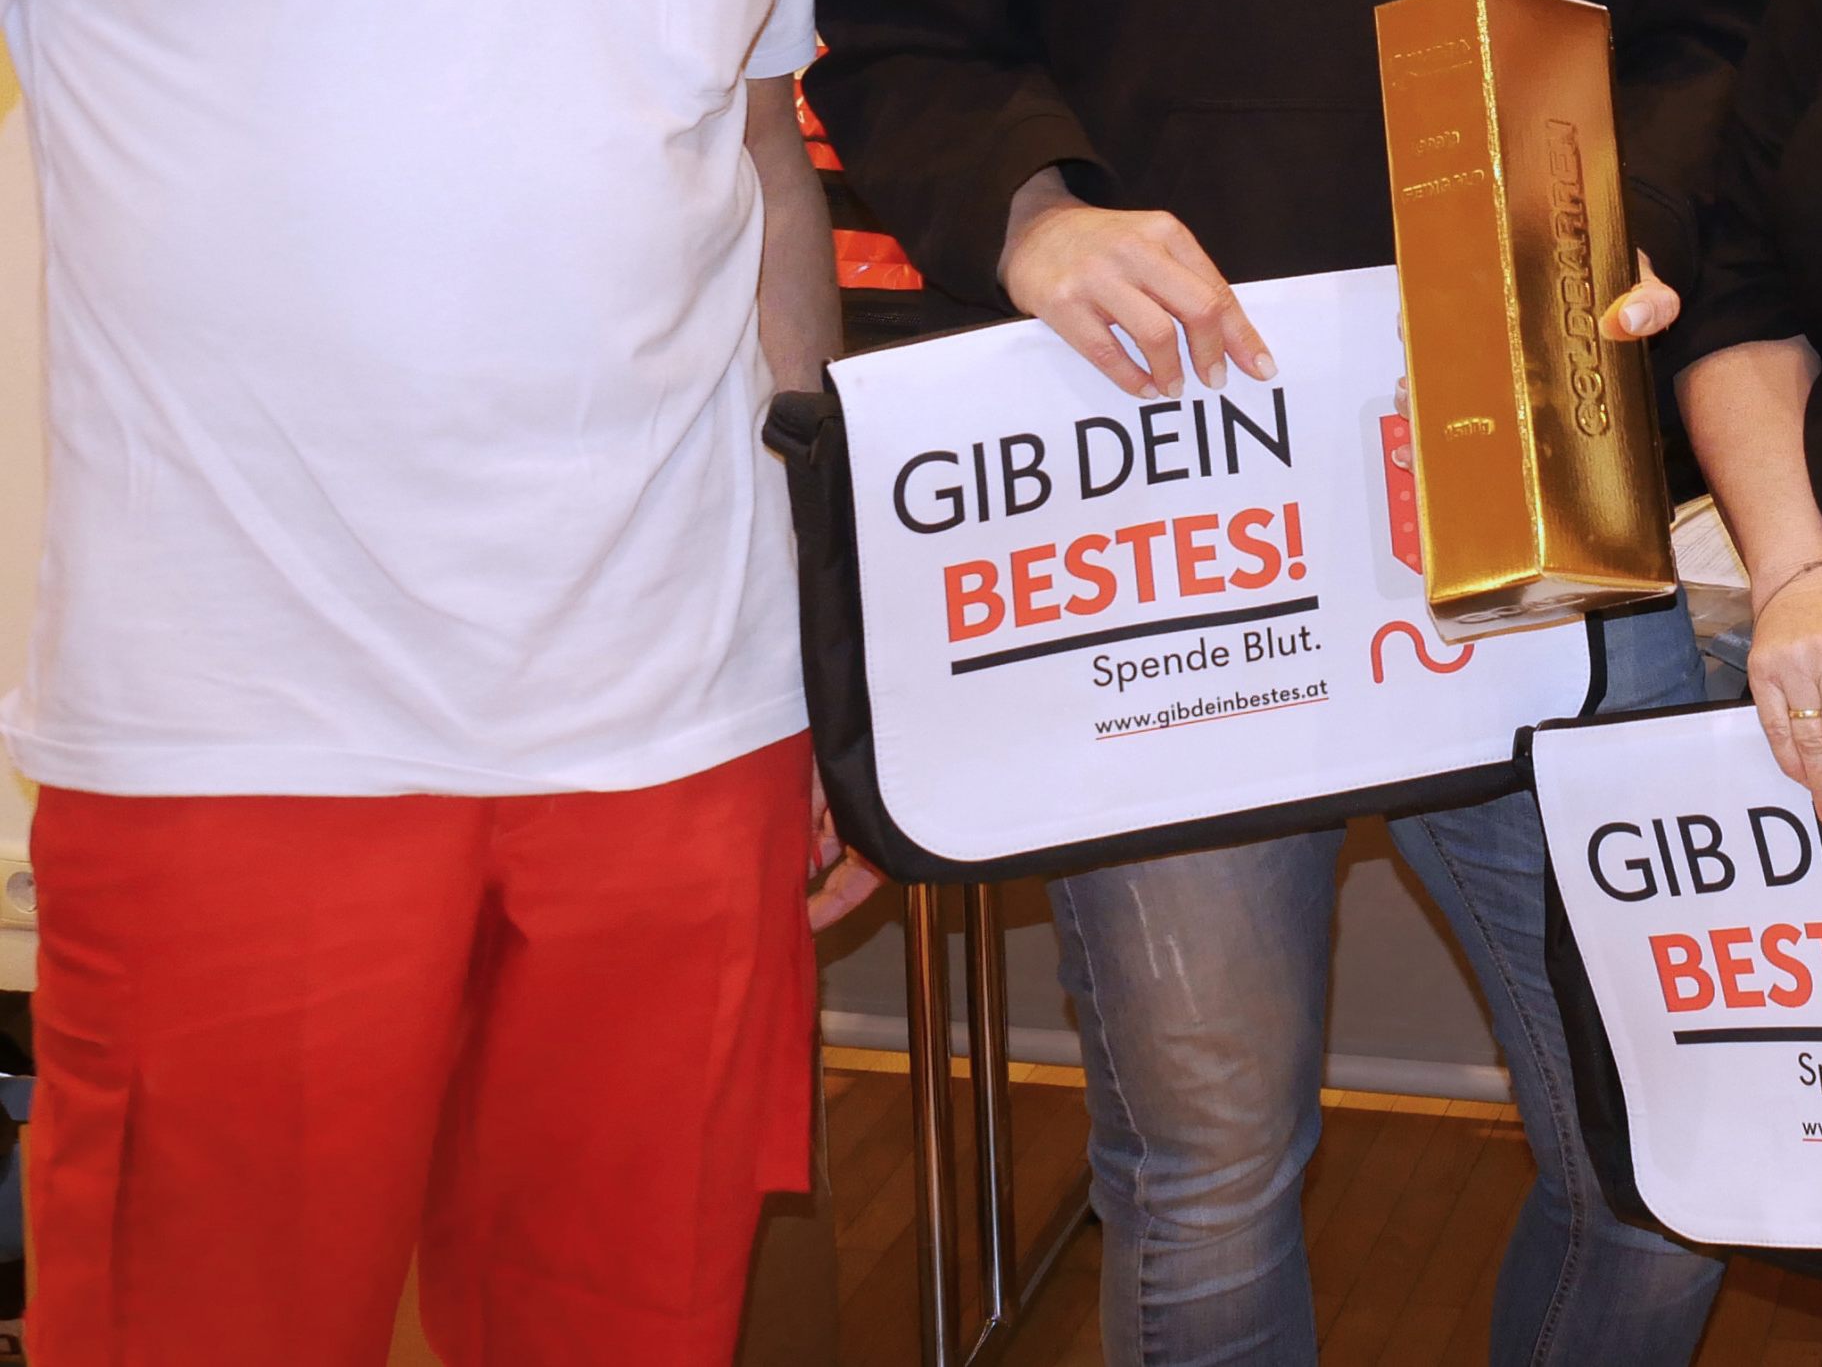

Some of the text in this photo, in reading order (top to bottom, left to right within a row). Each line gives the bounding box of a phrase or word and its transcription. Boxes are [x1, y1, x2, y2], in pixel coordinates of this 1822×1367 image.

[893, 387, 1292, 535] GIB DEIN
[943, 503, 1306, 643] BESTES!
[1092, 622, 1322, 693] Spende Blut.
[1094, 679, 1328, 735] www.gibdeinbestes.at
[1587, 814, 1736, 903] GIB
